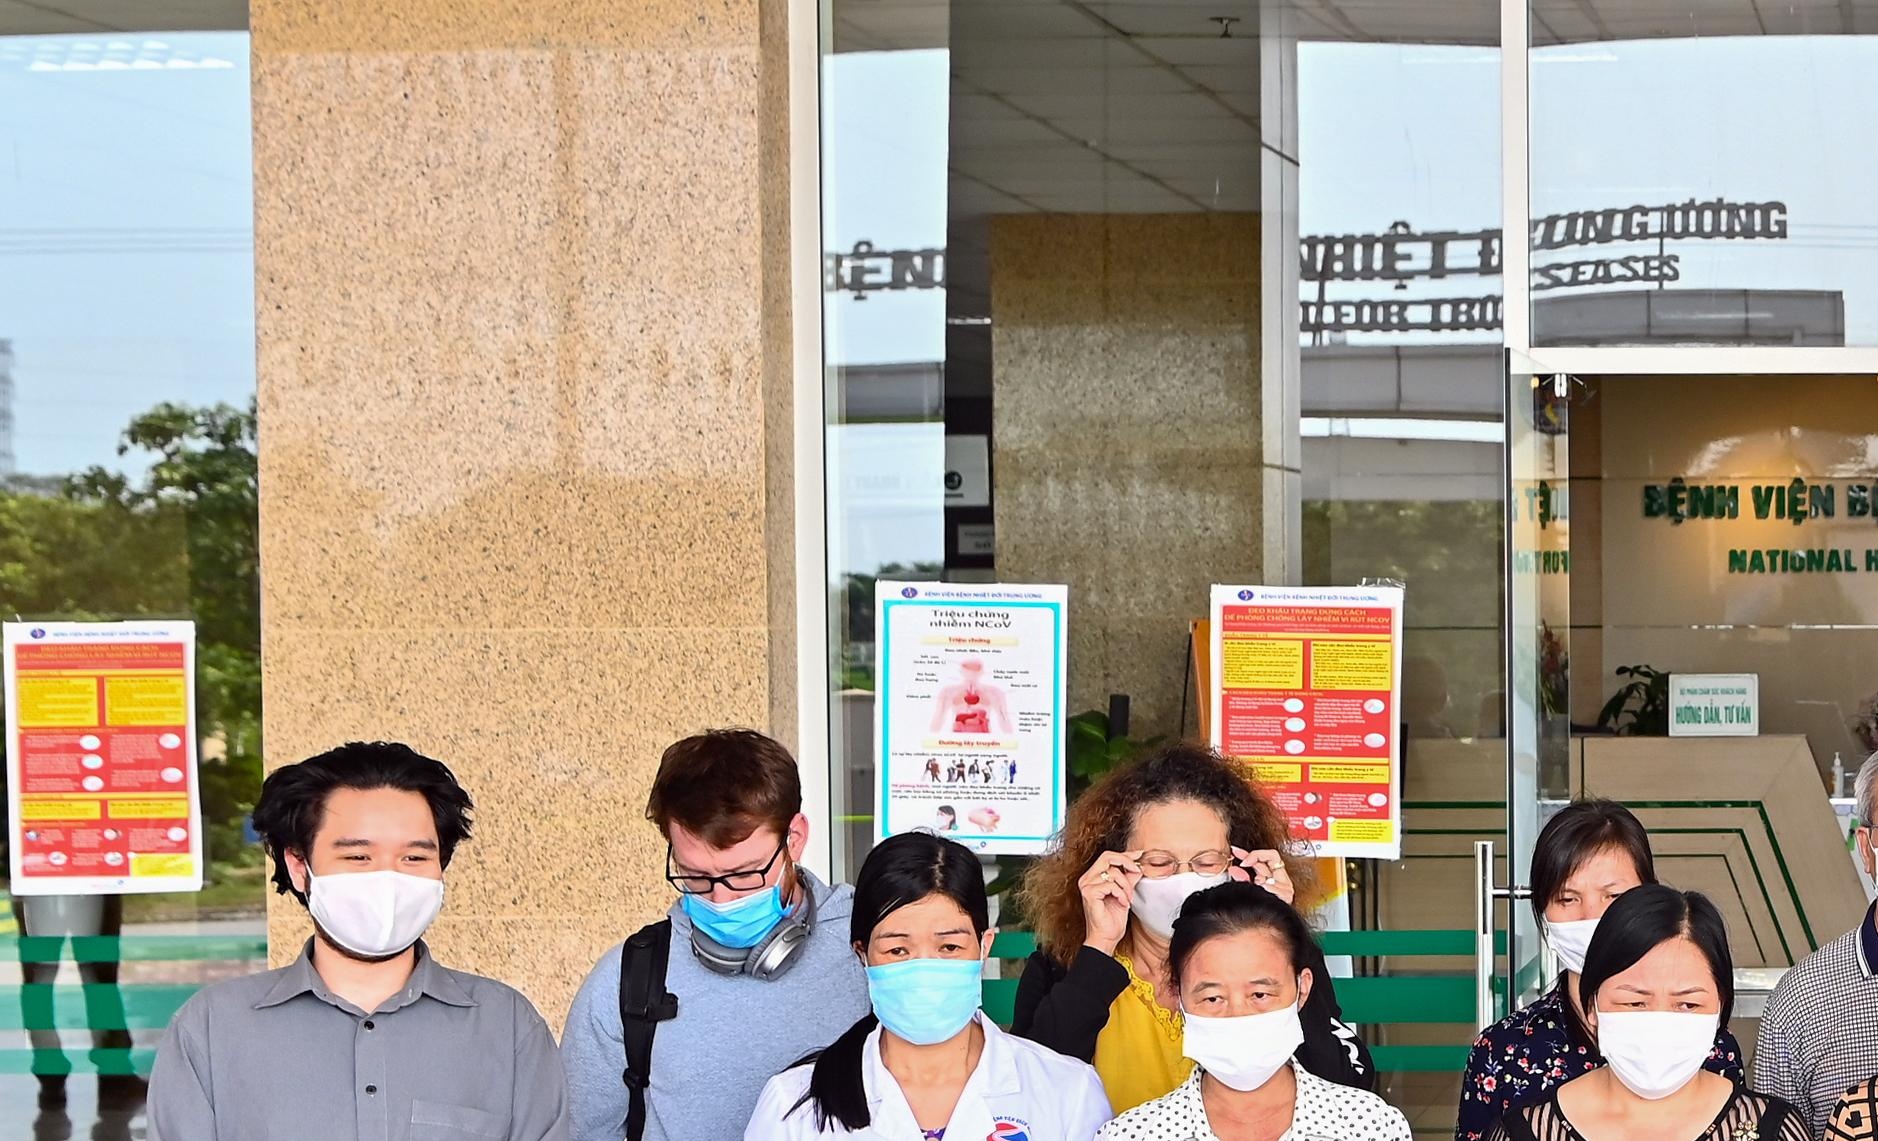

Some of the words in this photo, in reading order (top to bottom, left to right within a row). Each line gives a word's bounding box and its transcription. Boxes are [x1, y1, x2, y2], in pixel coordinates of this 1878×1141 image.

[1531, 204, 1648, 250] UNG
[1531, 254, 1680, 291] SEASES
[1643, 477, 1739, 525] BỆNH
[1752, 477, 1835, 525] VIỆN
[1728, 549, 1858, 574] NATIONAL
[932, 609, 964, 620] Triệu
[968, 609, 1009, 620] chứng
[975, 620, 1011, 628] NCoV
